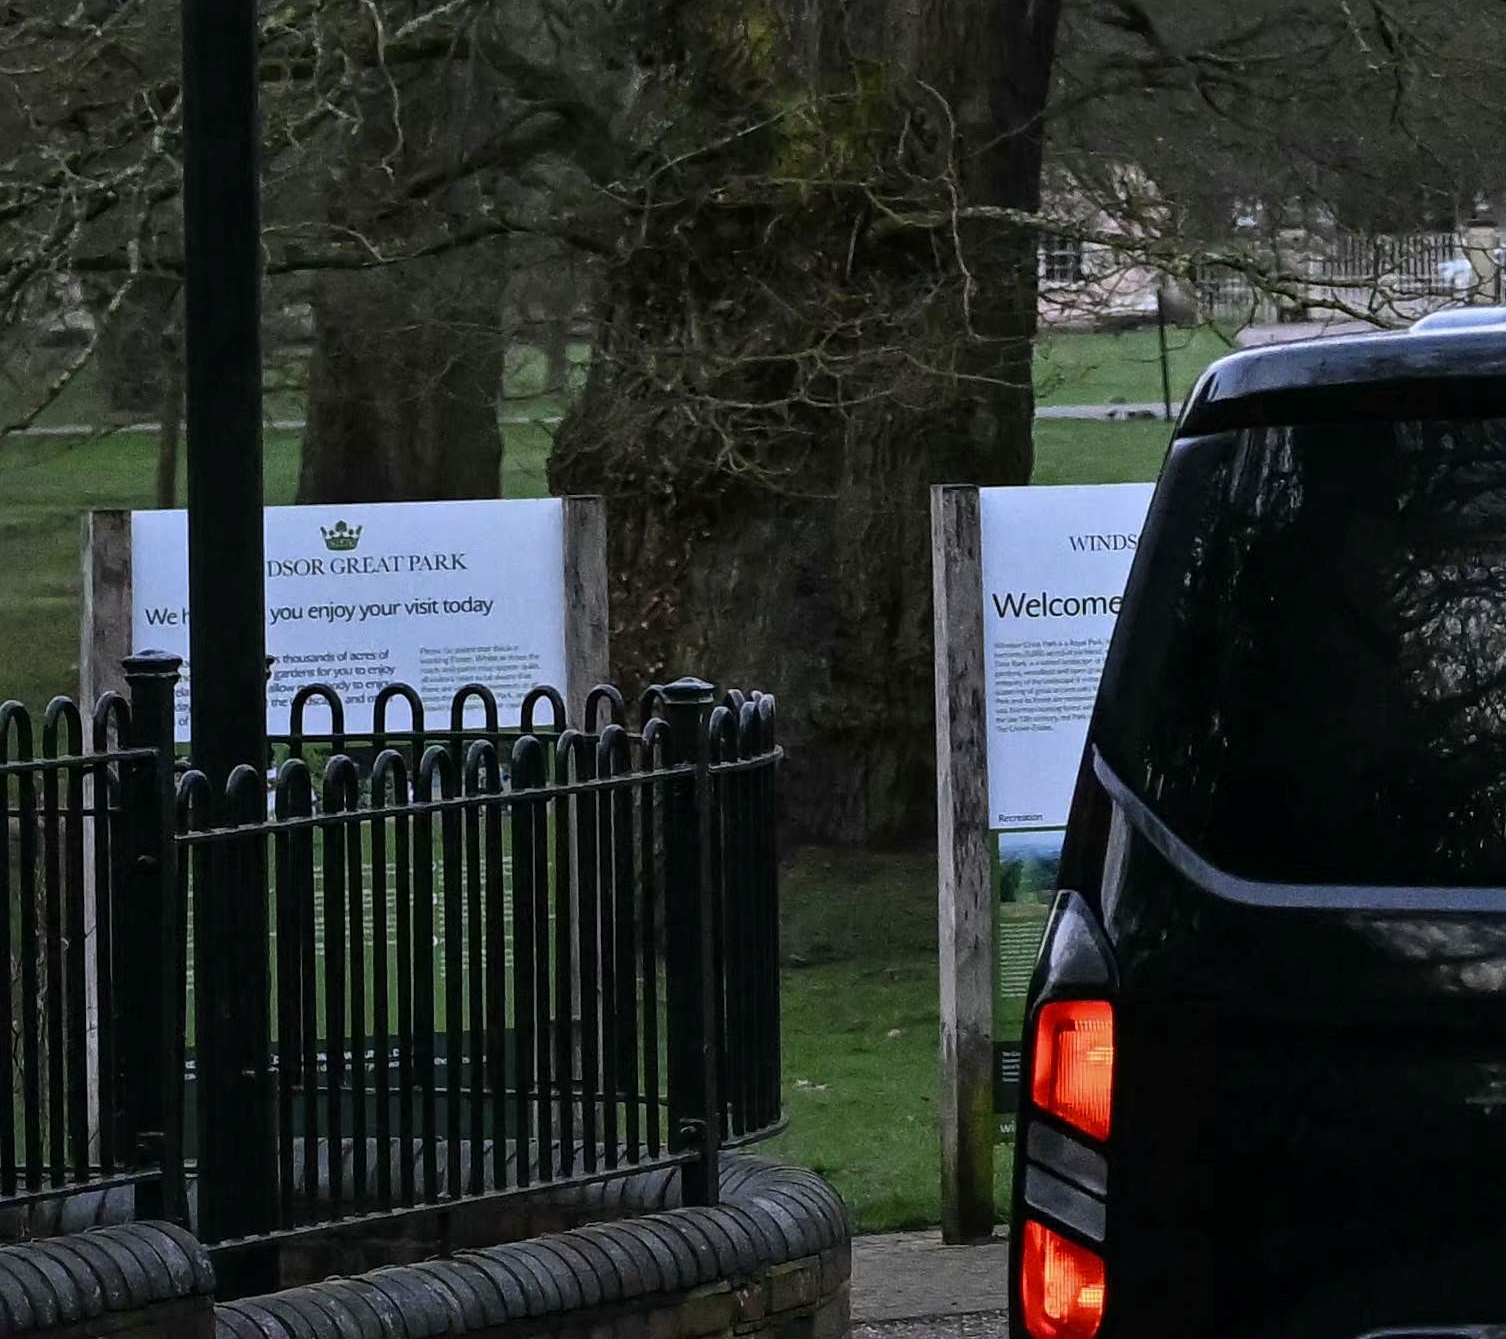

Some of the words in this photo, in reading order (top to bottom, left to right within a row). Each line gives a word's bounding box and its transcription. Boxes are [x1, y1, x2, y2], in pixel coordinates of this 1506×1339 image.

[1069, 533, 1138, 552] WINDS
[267, 557, 326, 577] DSOR
[330, 554, 406, 575] GREAT
[408, 552, 468, 572] PARK
[145, 607, 177, 625] We
[270, 604, 303, 625] you
[308, 600, 355, 622] enjoy
[358, 602, 401, 621] your
[405, 597, 439, 615] visit
[443, 596, 494, 616] today
[992, 591, 1124, 618] Welcome
[378, 649, 390, 660] of
[334, 667, 353, 679] you
[354, 666, 366, 676] to
[368, 664, 396, 677] enjoy
